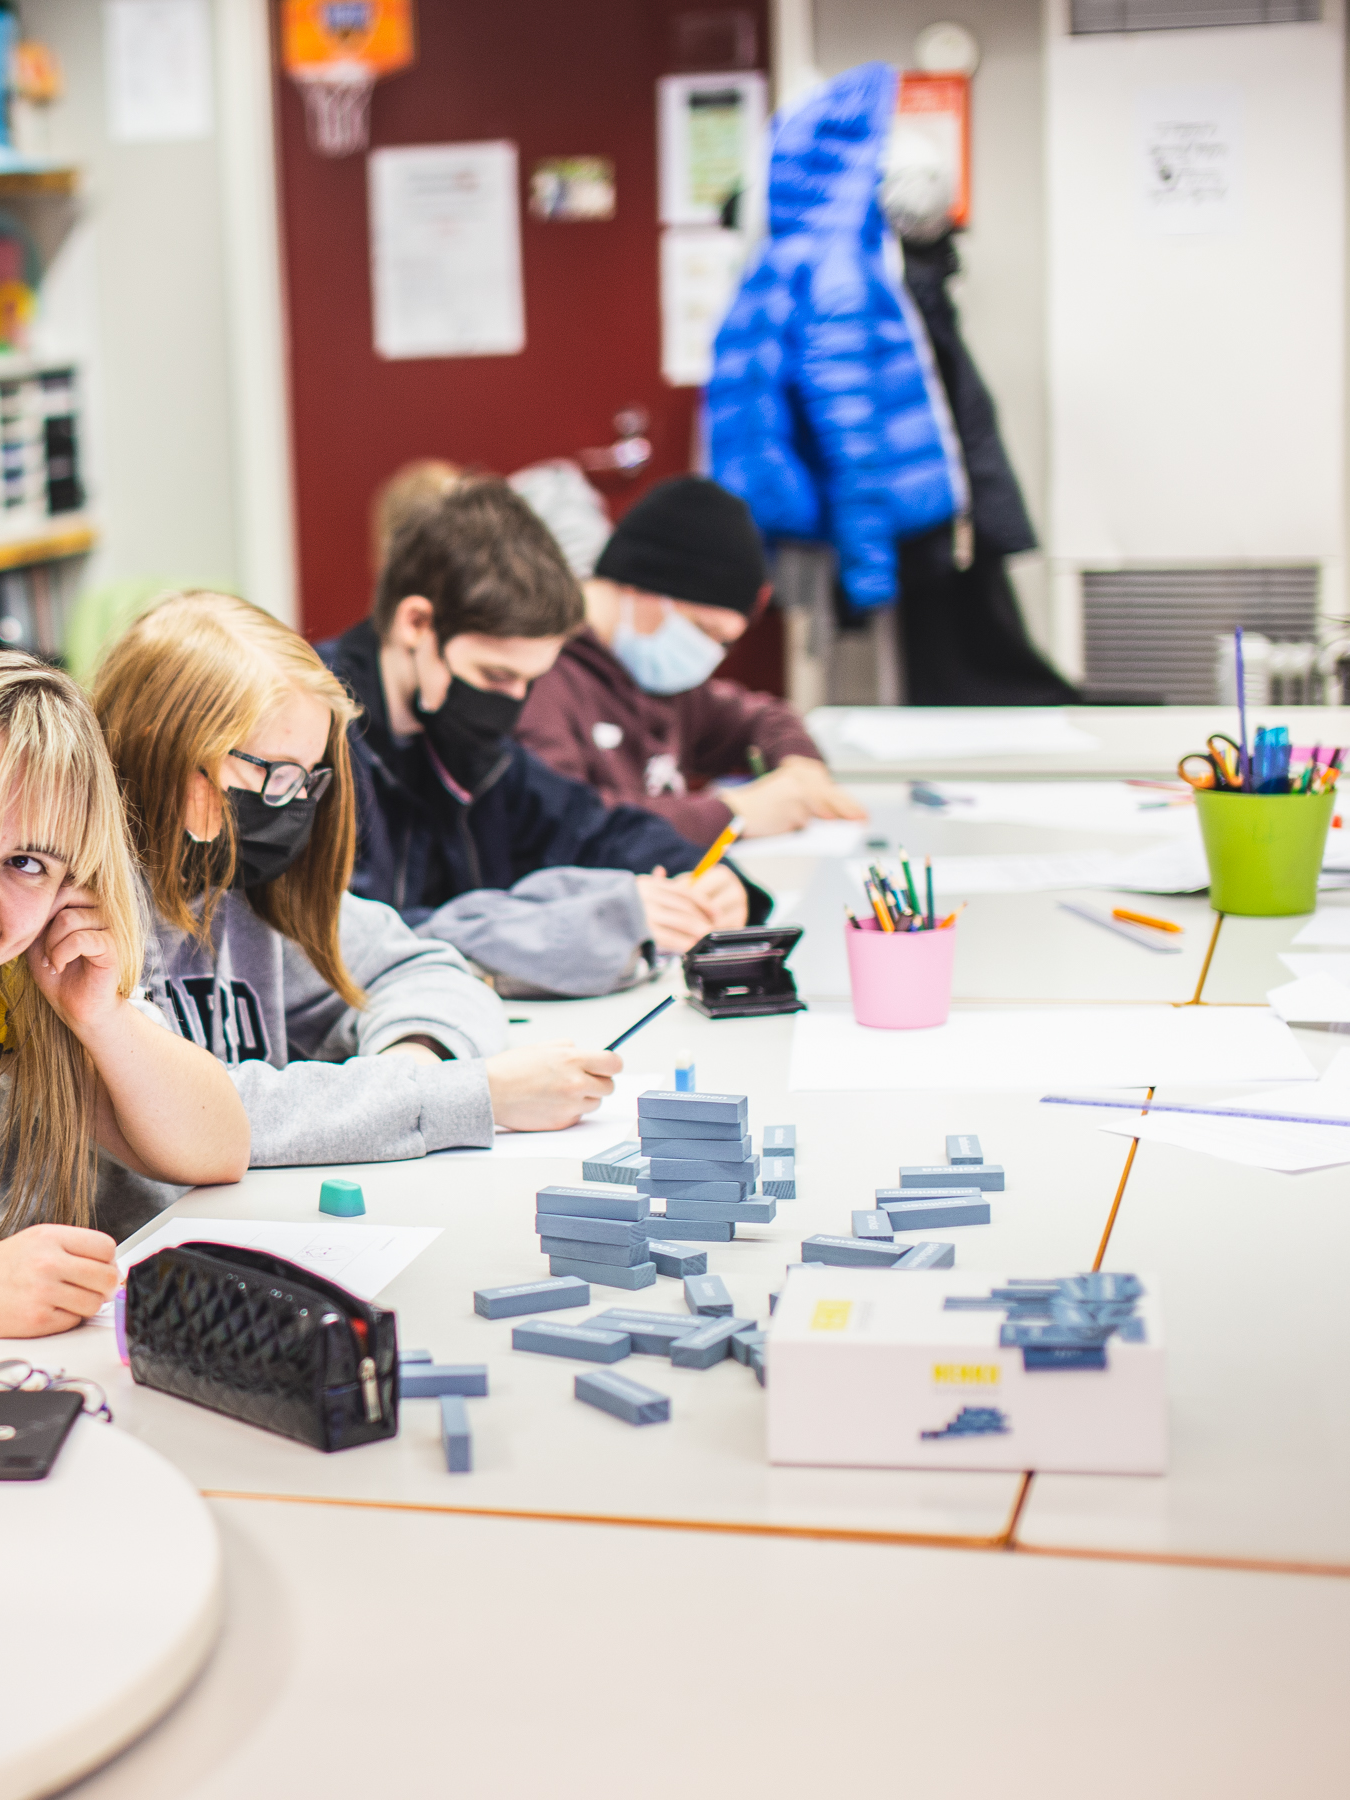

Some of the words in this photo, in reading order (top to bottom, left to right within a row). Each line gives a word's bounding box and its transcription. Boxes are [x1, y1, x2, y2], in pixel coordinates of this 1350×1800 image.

[657, 1090, 729, 1101] onnellinen
[922, 1165, 982, 1173] rohkea
[555, 1187, 631, 1198] innostunut
[883, 1188, 974, 1197] pitkäjänteinen
[901, 1198, 968, 1209] levollinen
[814, 1235, 900, 1250] haaveellinen
